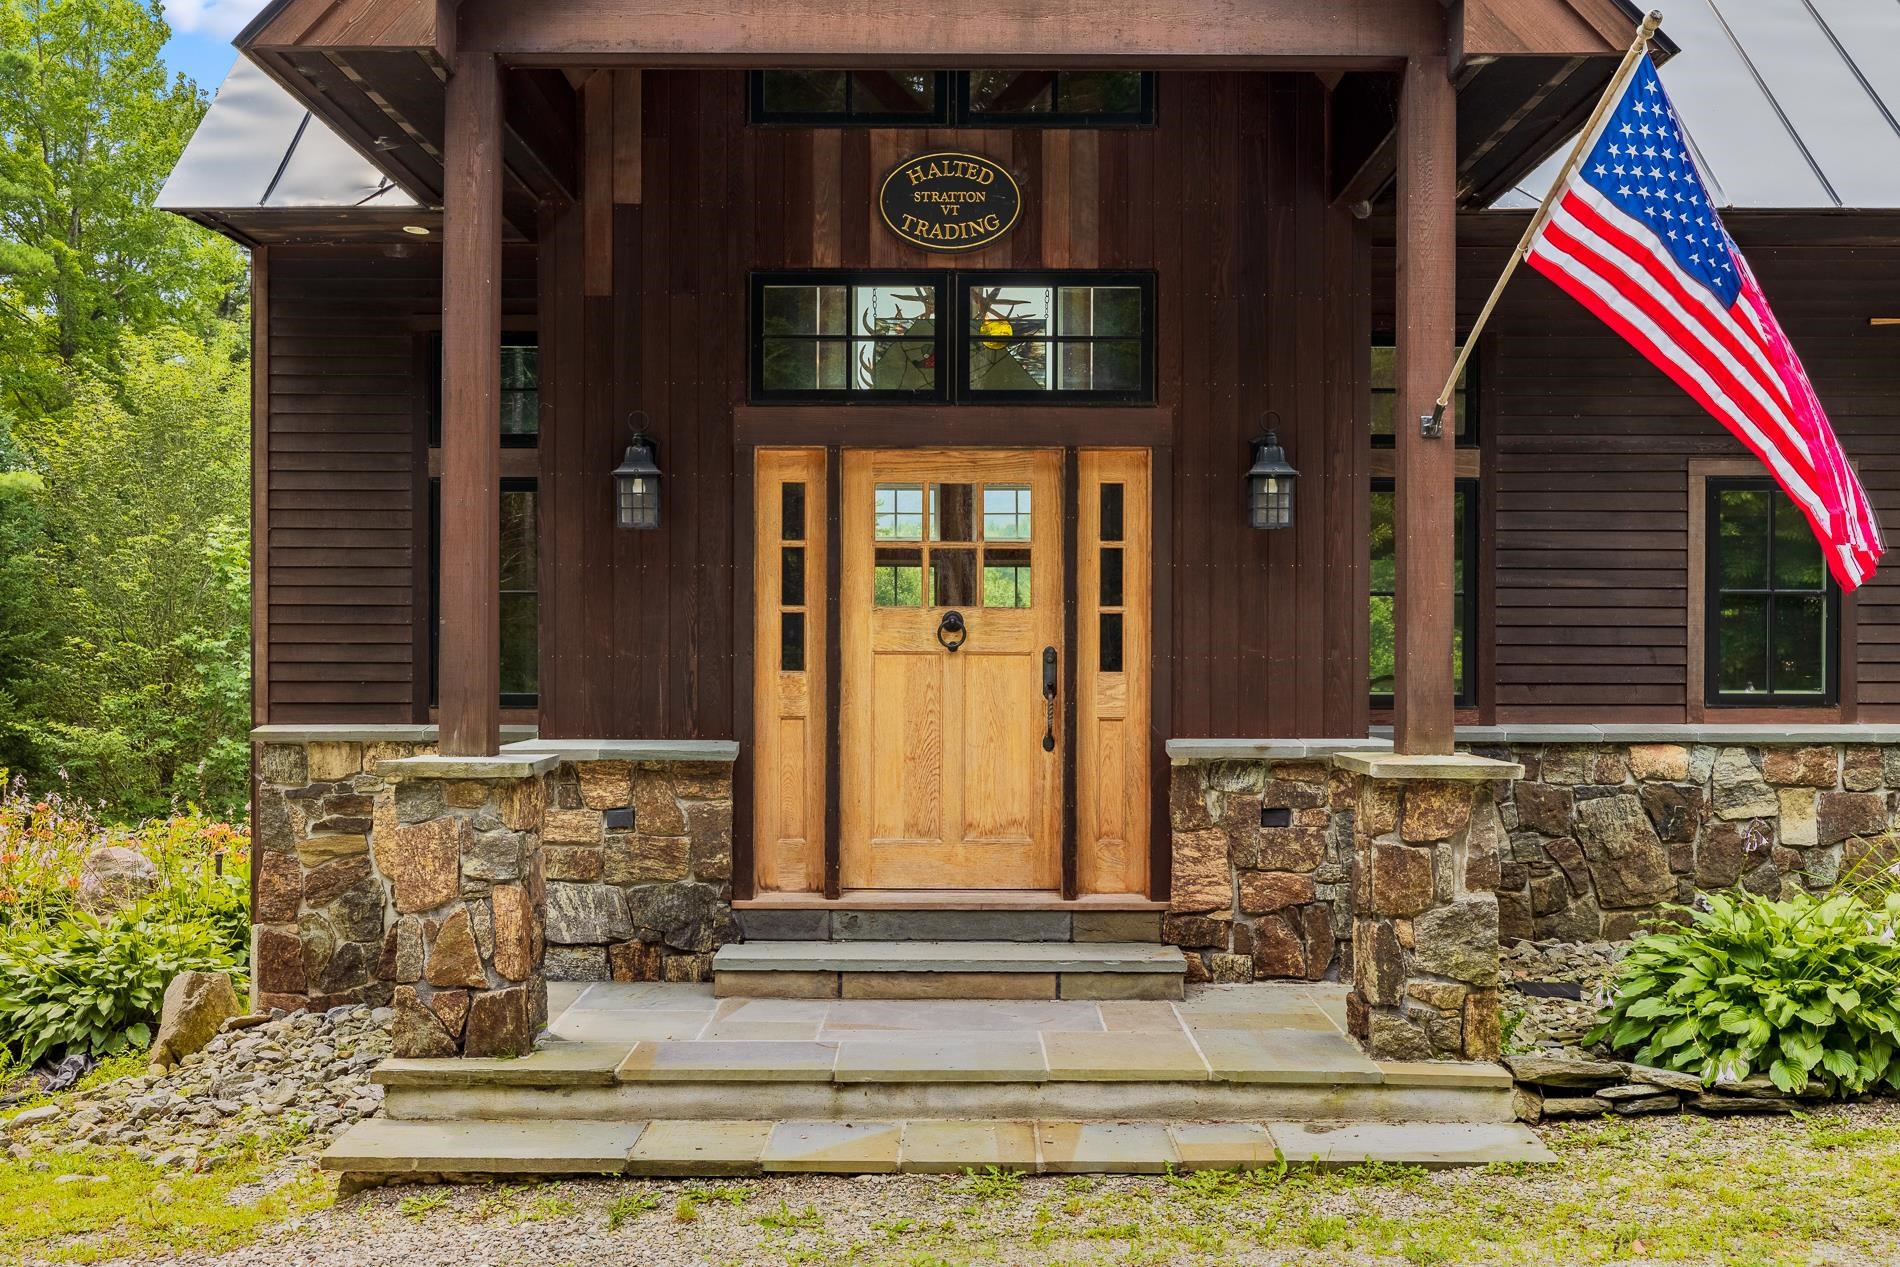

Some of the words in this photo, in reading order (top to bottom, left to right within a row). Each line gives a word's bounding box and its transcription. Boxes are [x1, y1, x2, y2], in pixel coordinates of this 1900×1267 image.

[906, 160, 994, 186] HALTED
[914, 191, 986, 202] STRATTON
[940, 205, 960, 216] VT
[901, 213, 1000, 240] TRADING
